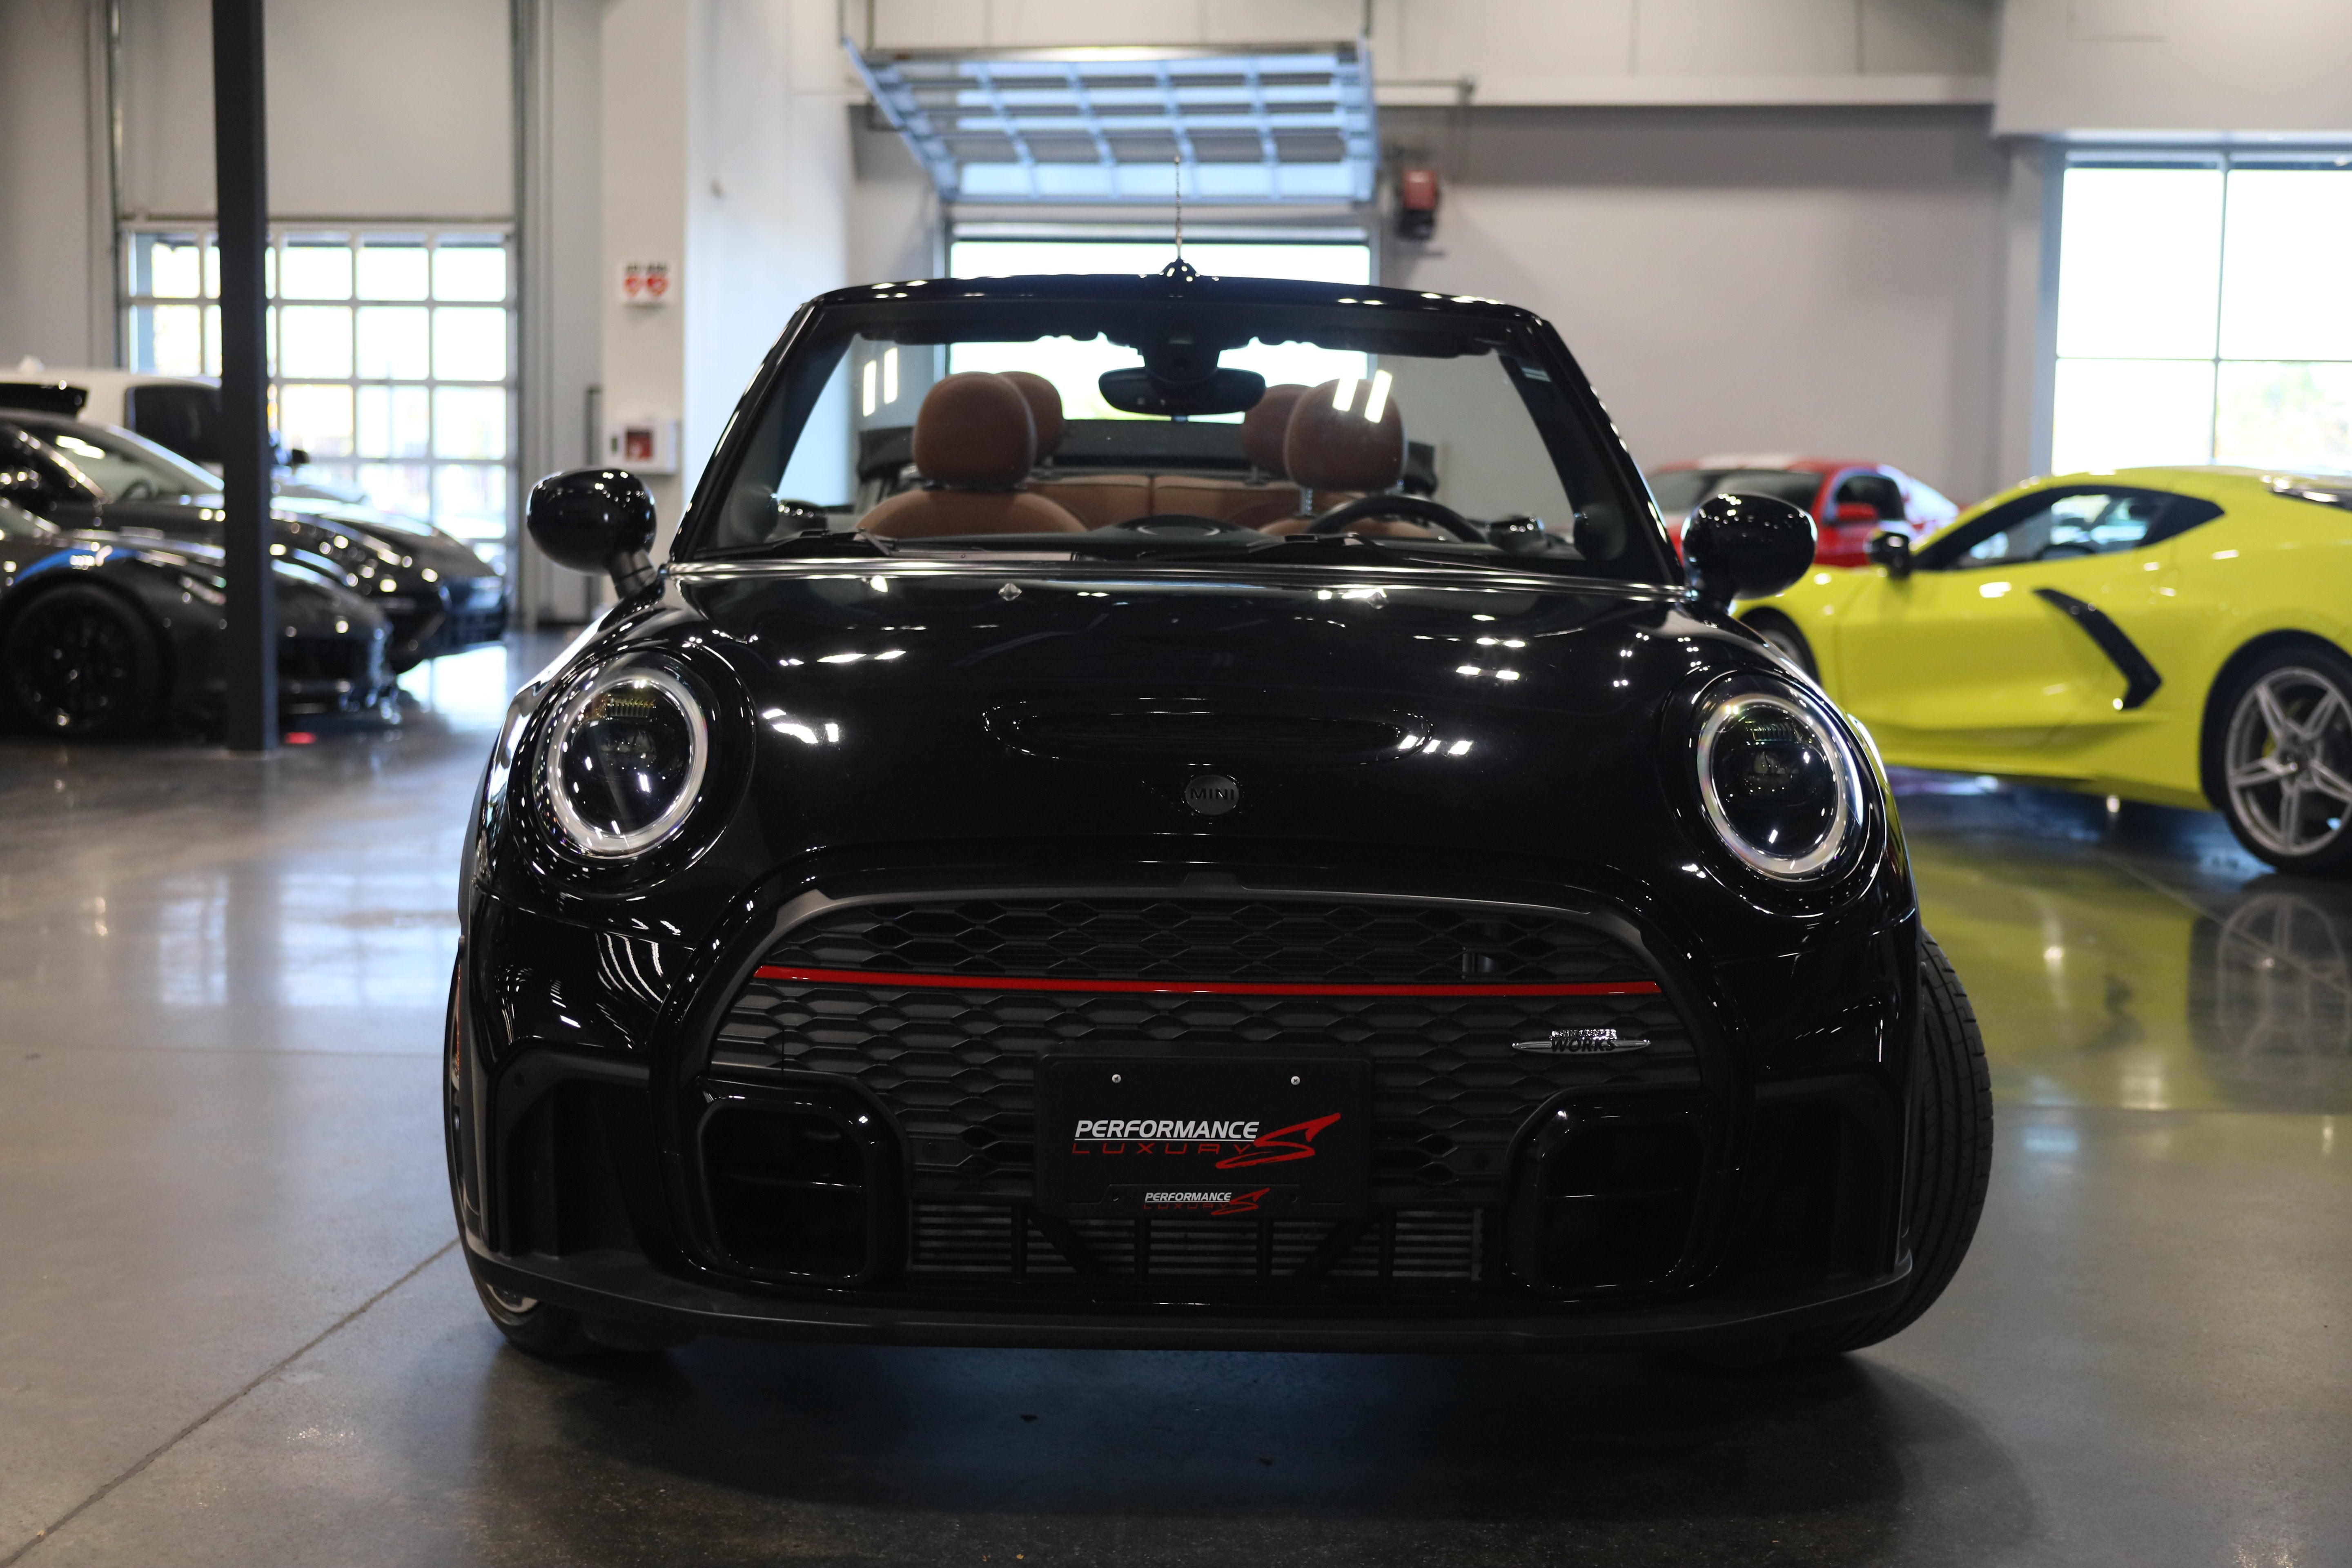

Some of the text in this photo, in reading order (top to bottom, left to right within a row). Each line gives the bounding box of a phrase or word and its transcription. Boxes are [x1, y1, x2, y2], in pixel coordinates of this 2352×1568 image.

[1190, 788, 1234, 800] MINI
[1551, 1038, 1616, 1052] WORKS
[1075, 1120, 1260, 1139] PERFORMANCE
[1071, 1143, 1252, 1154] LUXURY
[1144, 1192, 1232, 1201] PERFORMANCE
